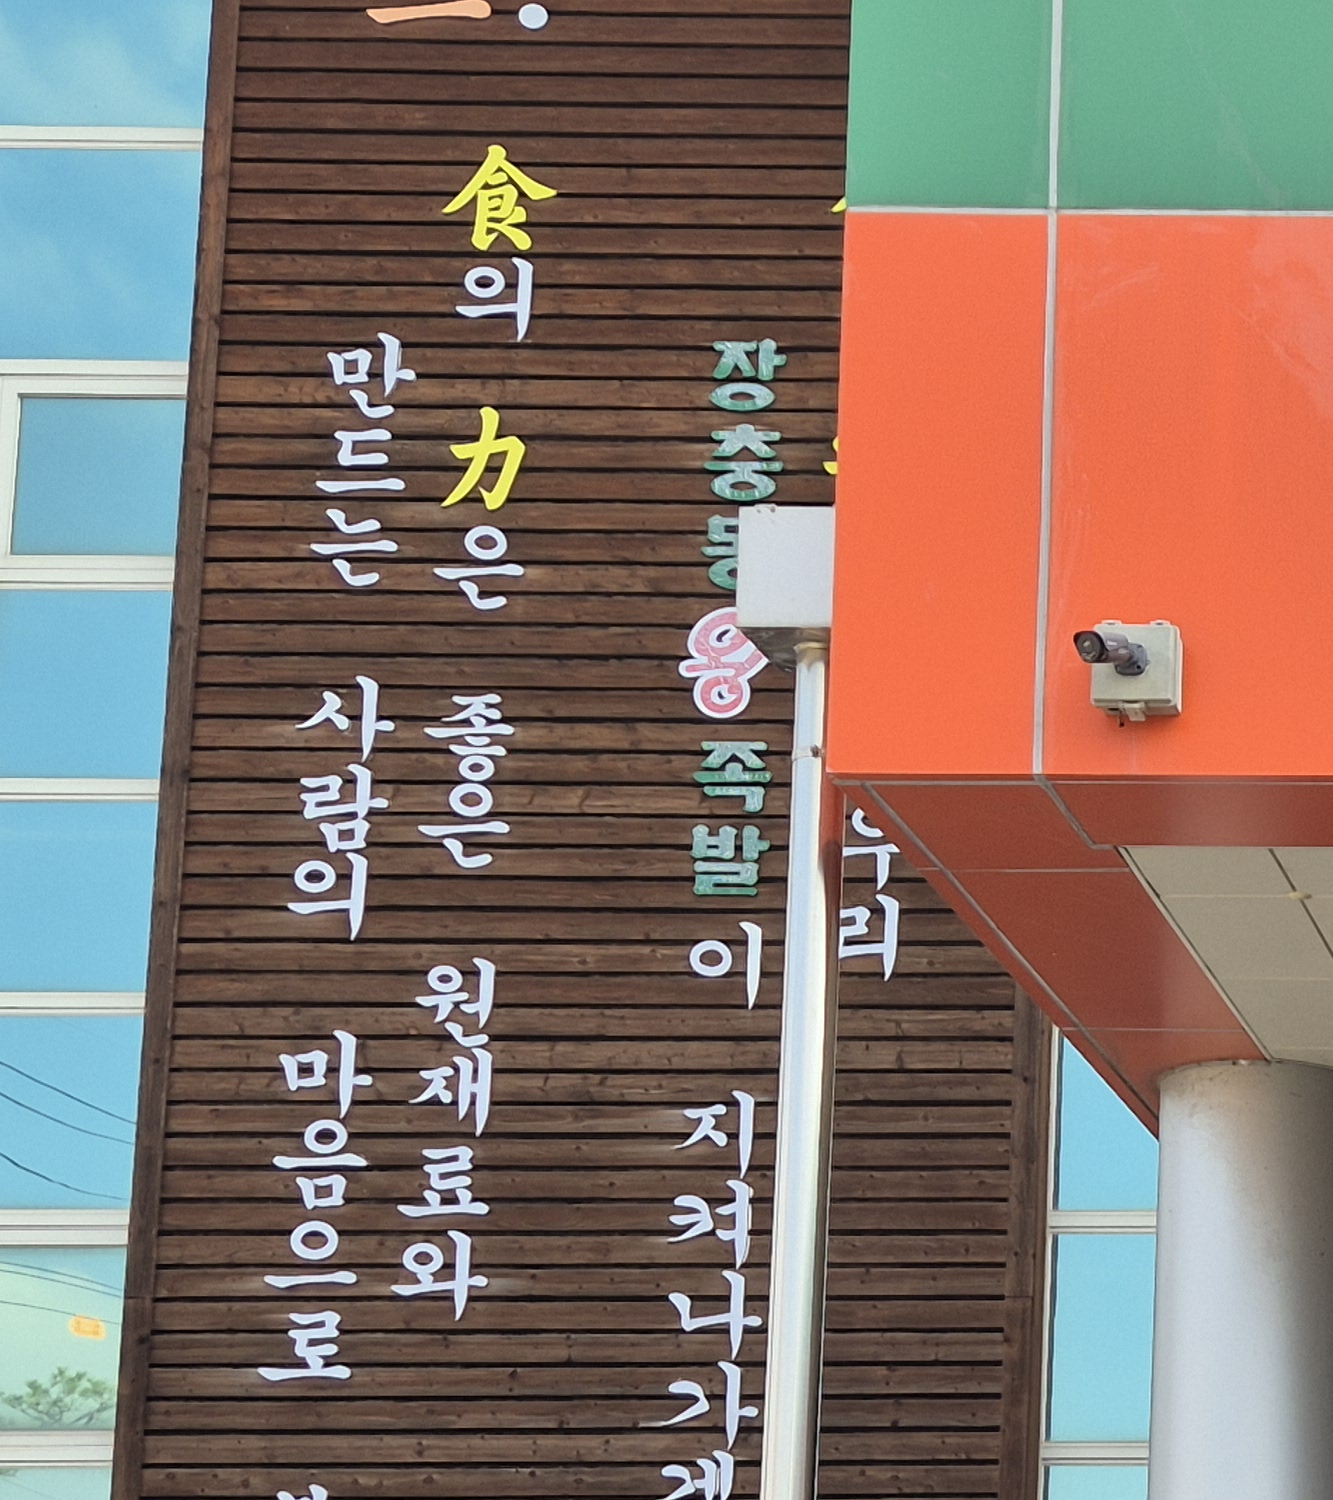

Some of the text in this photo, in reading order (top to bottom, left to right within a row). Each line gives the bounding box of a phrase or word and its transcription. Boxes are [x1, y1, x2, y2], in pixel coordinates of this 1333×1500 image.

[309, 332, 416, 587] 만드는
[287, 675, 395, 940] 사람의
[390, 145, 557, 1320] 食의 力은 좋은 원재료와
[256, 1029, 373, 1380] 마음으로
